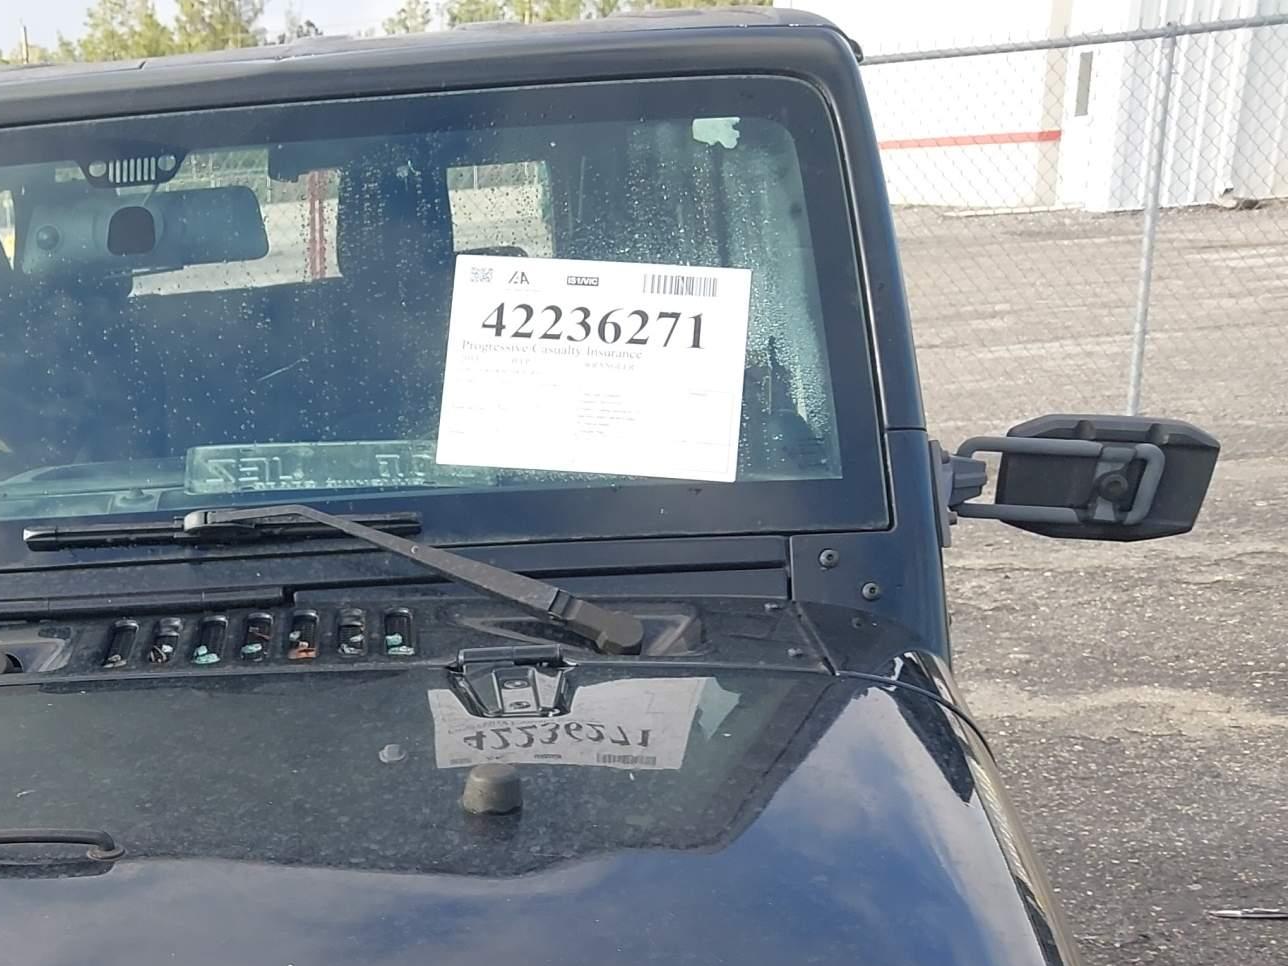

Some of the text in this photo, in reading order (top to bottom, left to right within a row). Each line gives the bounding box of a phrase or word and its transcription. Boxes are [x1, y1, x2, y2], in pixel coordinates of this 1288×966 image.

[481, 302, 705, 350] 42236271
[461, 339, 644, 360] Progressive Casualty Insurance
